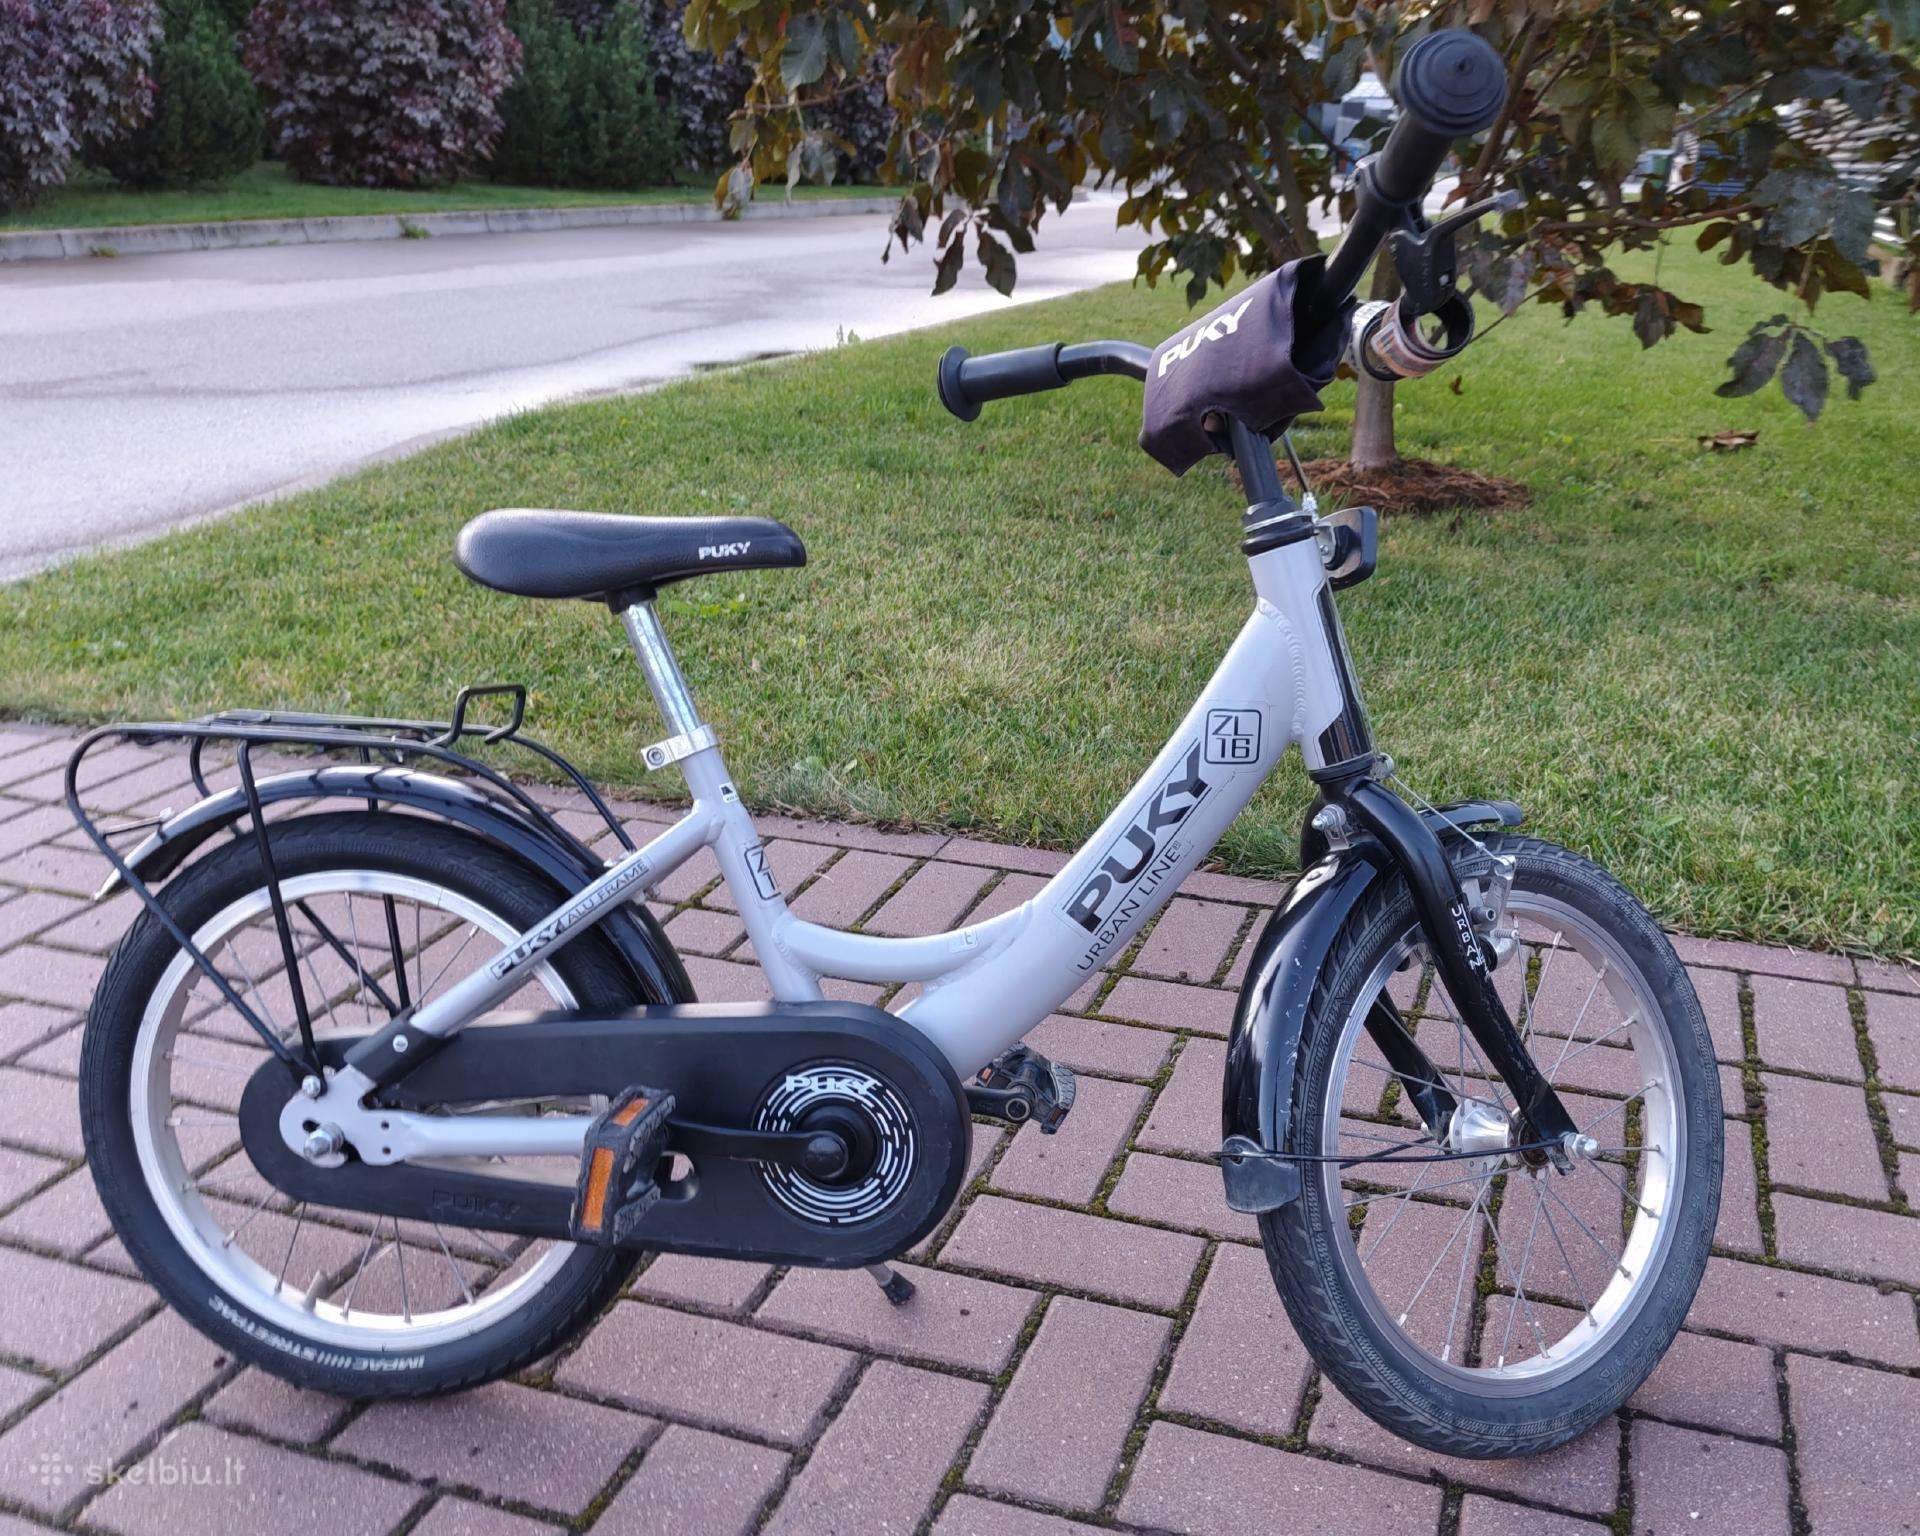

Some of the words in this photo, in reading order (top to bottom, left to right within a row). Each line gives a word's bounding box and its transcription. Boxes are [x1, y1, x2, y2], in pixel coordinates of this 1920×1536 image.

[1157, 297, 1255, 379] PUKY
[697, 540, 752, 560] PUKY
[1211, 714, 1255, 737] ZL
[1216, 737, 1251, 760] 16
[1065, 740, 1210, 934] PUKY
[491, 919, 565, 976] PUKY
[567, 899, 596, 925] ALU
[596, 860, 650, 902] FRAME
[1076, 899, 1141, 972] URBAN
[1451, 903, 1484, 971] URBAN
[785, 1075, 876, 1095] PUKY
